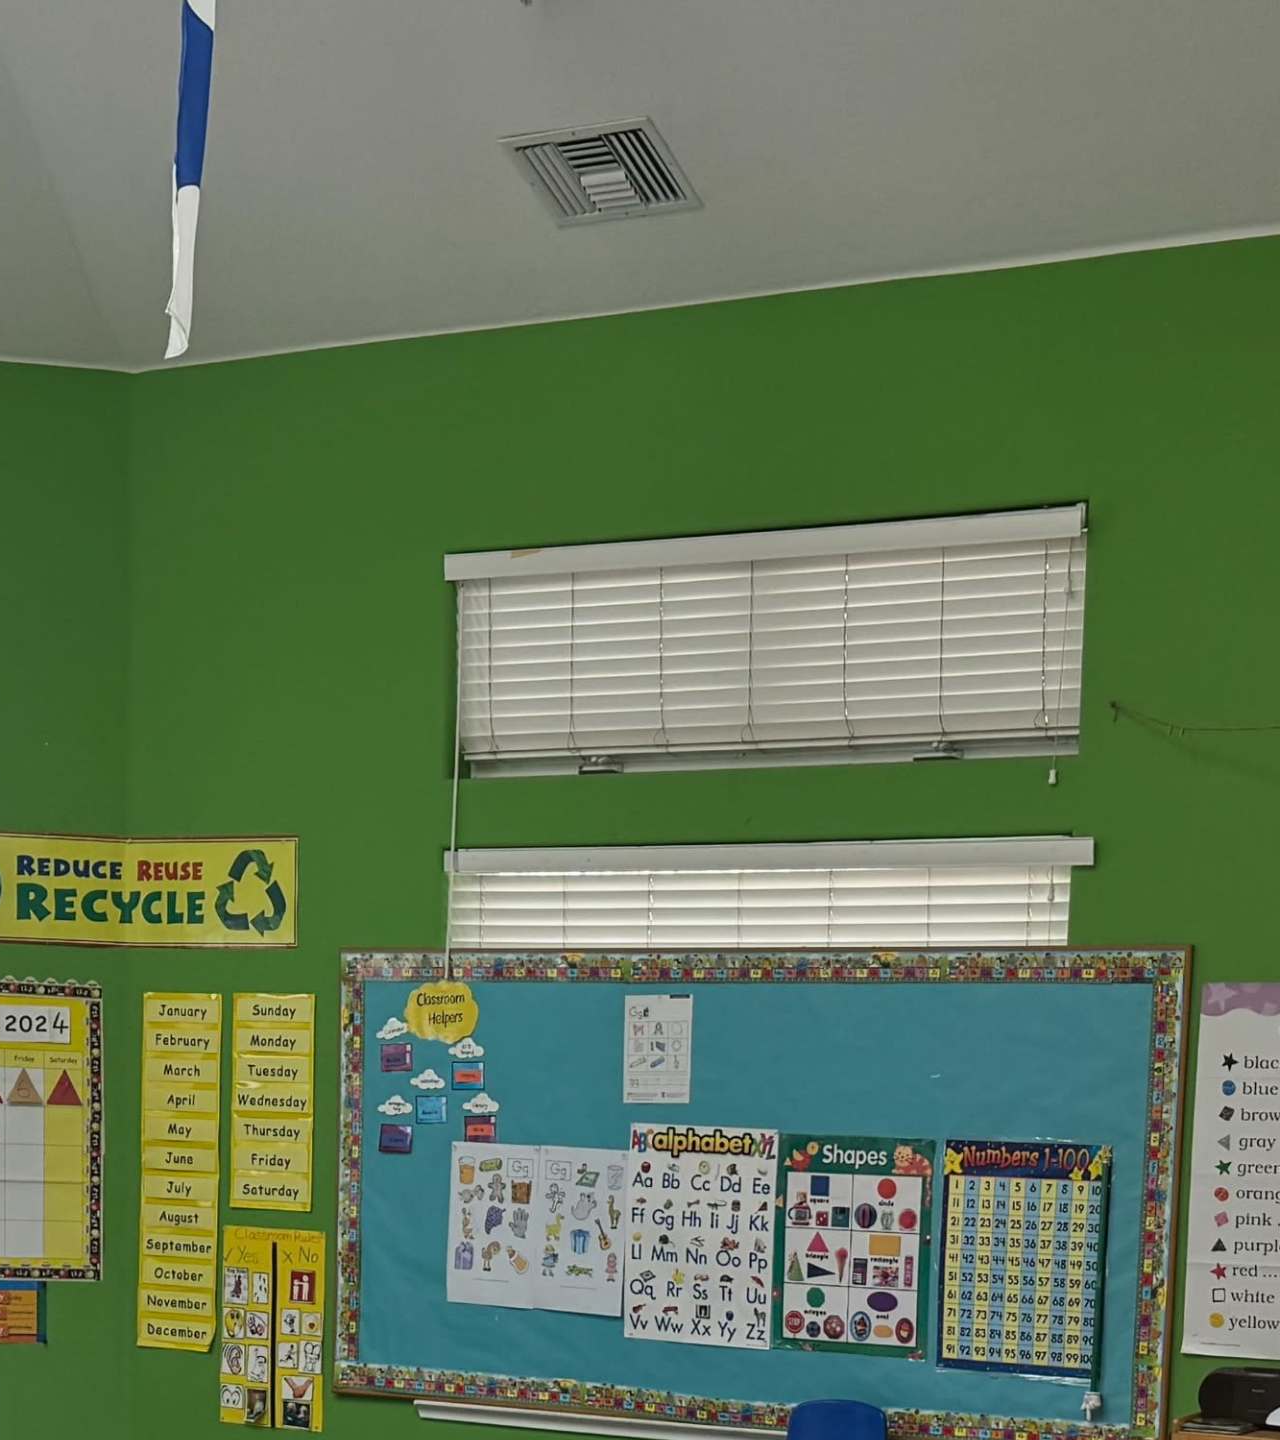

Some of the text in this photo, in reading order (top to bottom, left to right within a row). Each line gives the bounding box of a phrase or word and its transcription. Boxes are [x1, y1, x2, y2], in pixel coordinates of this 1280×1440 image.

[16, 855, 203, 882] REDUCE REUSE
[15, 883, 206, 925] RECYCLE
[416, 993, 465, 1007] Classroom
[158, 1004, 208, 1020] January
[252, 1004, 297, 1020] Sunday
[428, 1011, 463, 1028] Helpers
[4, 1012, 69, 1034] 2024
[155, 1034, 210, 1050] February
[250, 1035, 296, 1051] Monday
[163, 1064, 201, 1077] March
[248, 1064, 298, 1080] Tuesday
[1242, 1081, 1279, 1096] blue
[167, 1094, 196, 1109] April
[237, 1093, 307, 1111] Wednesday
[168, 1124, 192, 1138] May
[243, 1124, 300, 1141] Thursday
[652, 1127, 754, 1158] alphabet
[1238, 1135, 1276, 1151] gray
[165, 1152, 194, 1165] June
[250, 1153, 291, 1169] Friday
[822, 1144, 888, 1169] Shapes
[963, 1146, 1089, 1172] Numbers 1-100
[512, 1160, 529, 1177] Gg
[166, 1181, 192, 1196] July
[632, 1172, 770, 1195] Aa Bb Cc Dd Ee
[955, 1181, 959, 1190] 1
[969, 1181, 975, 1190] 2
[984, 1181, 990, 1191] 3
[999, 1181, 1006, 1191] 4
[1015, 1183, 1021, 1192] 5
[1030, 1183, 1037, 1193] 6
[1045, 1184, 1052, 1194] 7
[1061, 1184, 1068, 1194] 8
[1077, 1185, 1084, 1194] 9
[242, 1184, 299, 1200] Saturday
[159, 1210, 199, 1226] August
[631, 1207, 769, 1235] Ff Gg Hh Ii Jj Kk
[1235, 1213, 1272, 1229] pink
[234, 1229, 293, 1242] Classroom
[146, 1239, 212, 1254] September
[239, 1246, 319, 1264] Yes No
[631, 1243, 768, 1274] Ll Mm Nn Oo Pp
[154, 1267, 203, 1282] October
[1232, 1264, 1259, 1277] red
[630, 1279, 767, 1305] Qq Rr Ss Tt Uu
[1230, 1289, 1275, 1304] white
[147, 1294, 207, 1311] November
[147, 1322, 207, 1339] December
[630, 1314, 765, 1343] Vv Ww Xx Yy Zz
[1228, 1315, 1280, 1331] yellow
